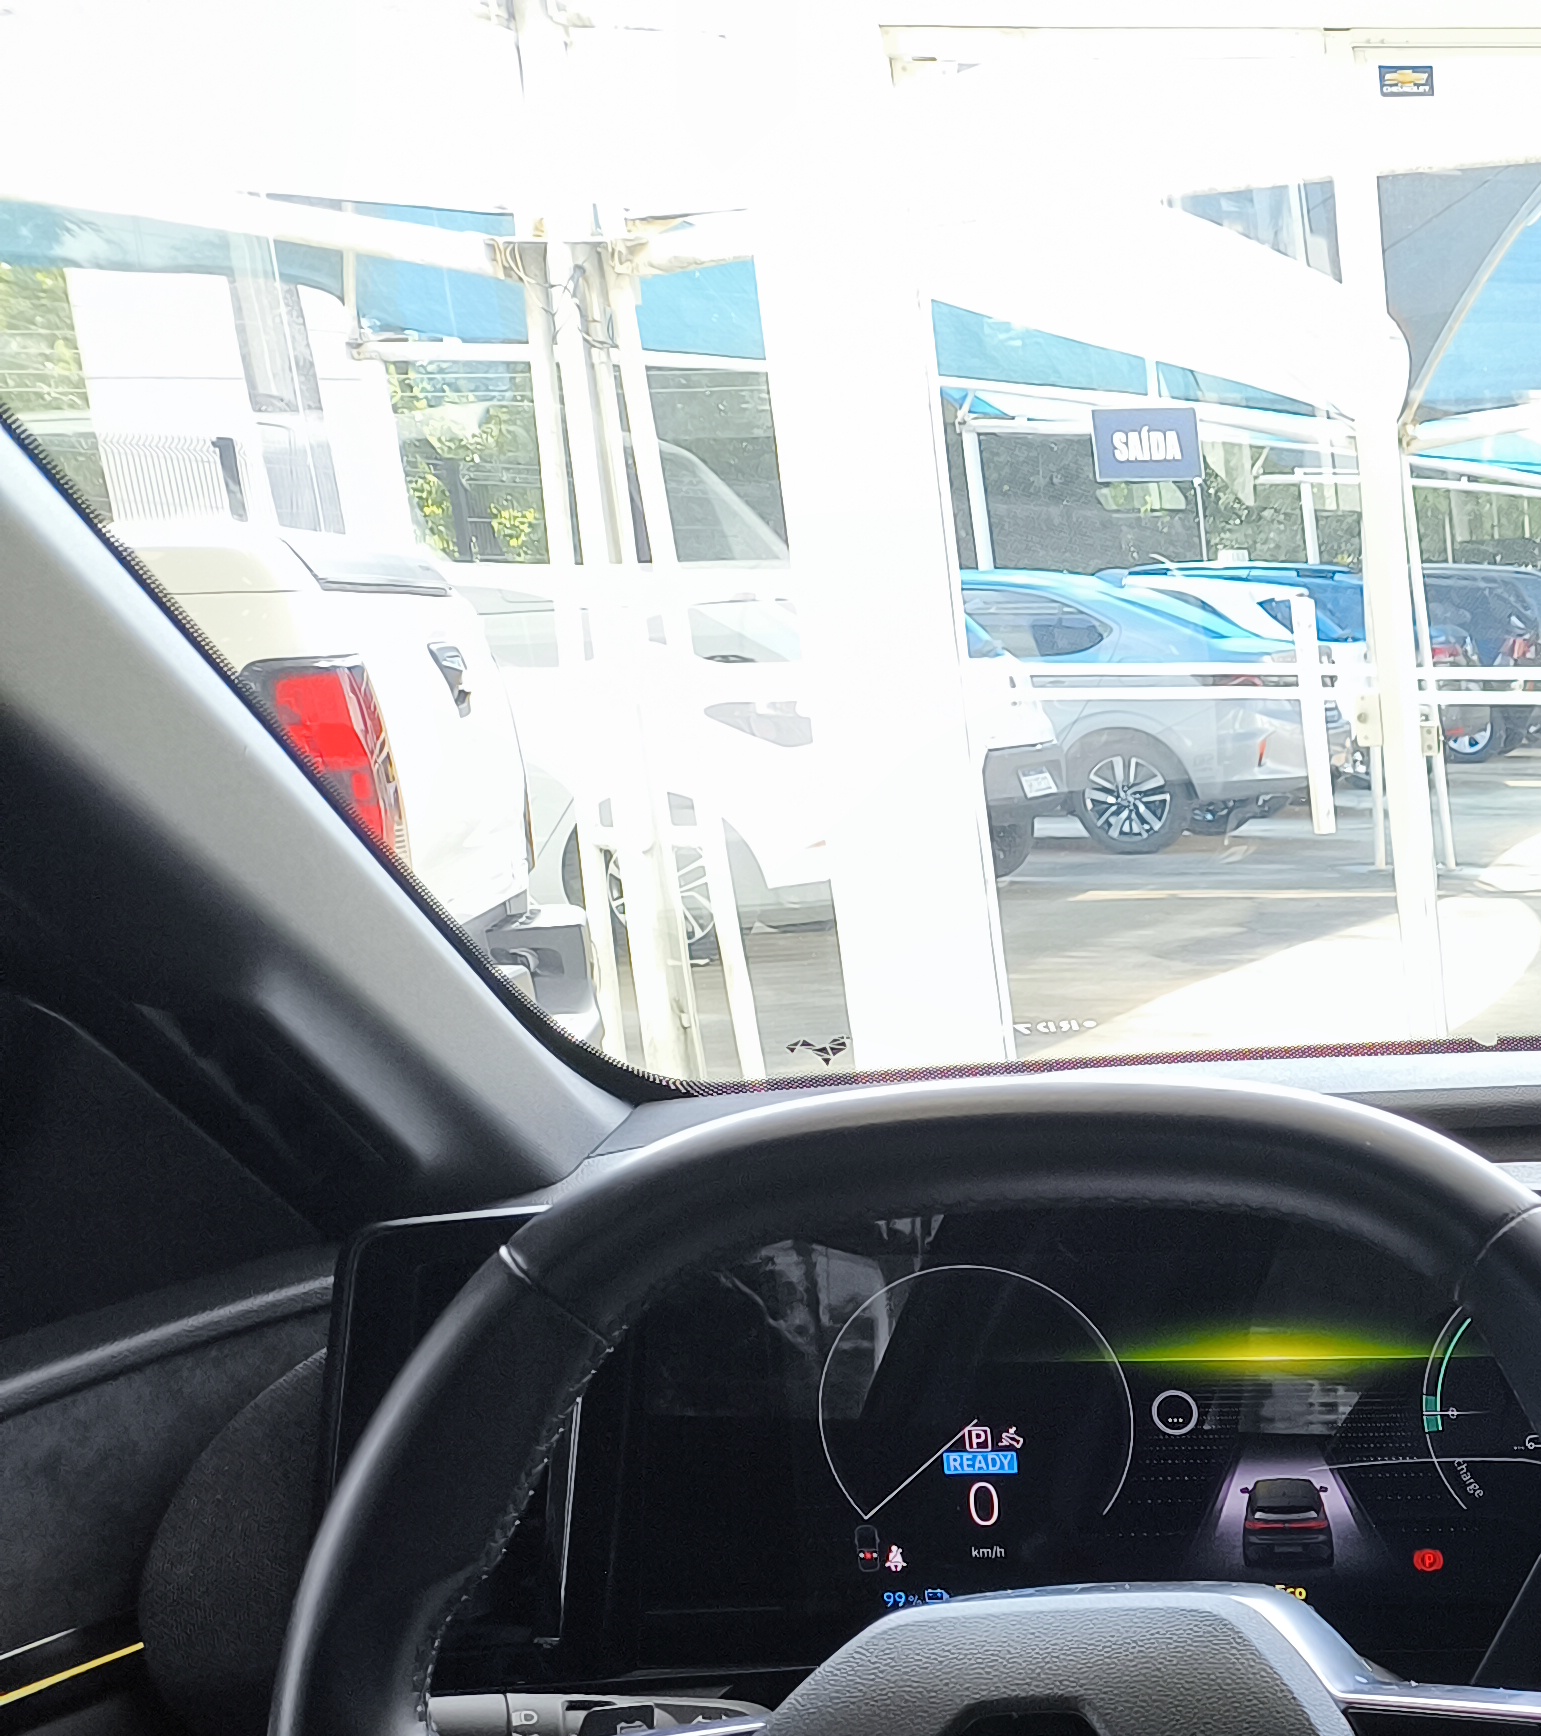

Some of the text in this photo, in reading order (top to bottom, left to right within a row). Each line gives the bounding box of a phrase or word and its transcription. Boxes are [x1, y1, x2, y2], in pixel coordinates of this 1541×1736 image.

[1112, 425, 1183, 462] SAÍDA
[950, 1454, 1012, 1472] READY
[1453, 1459, 1485, 1499] charge
[969, 1481, 999, 1526] 0
[971, 1546, 1005, 1559] km/h
